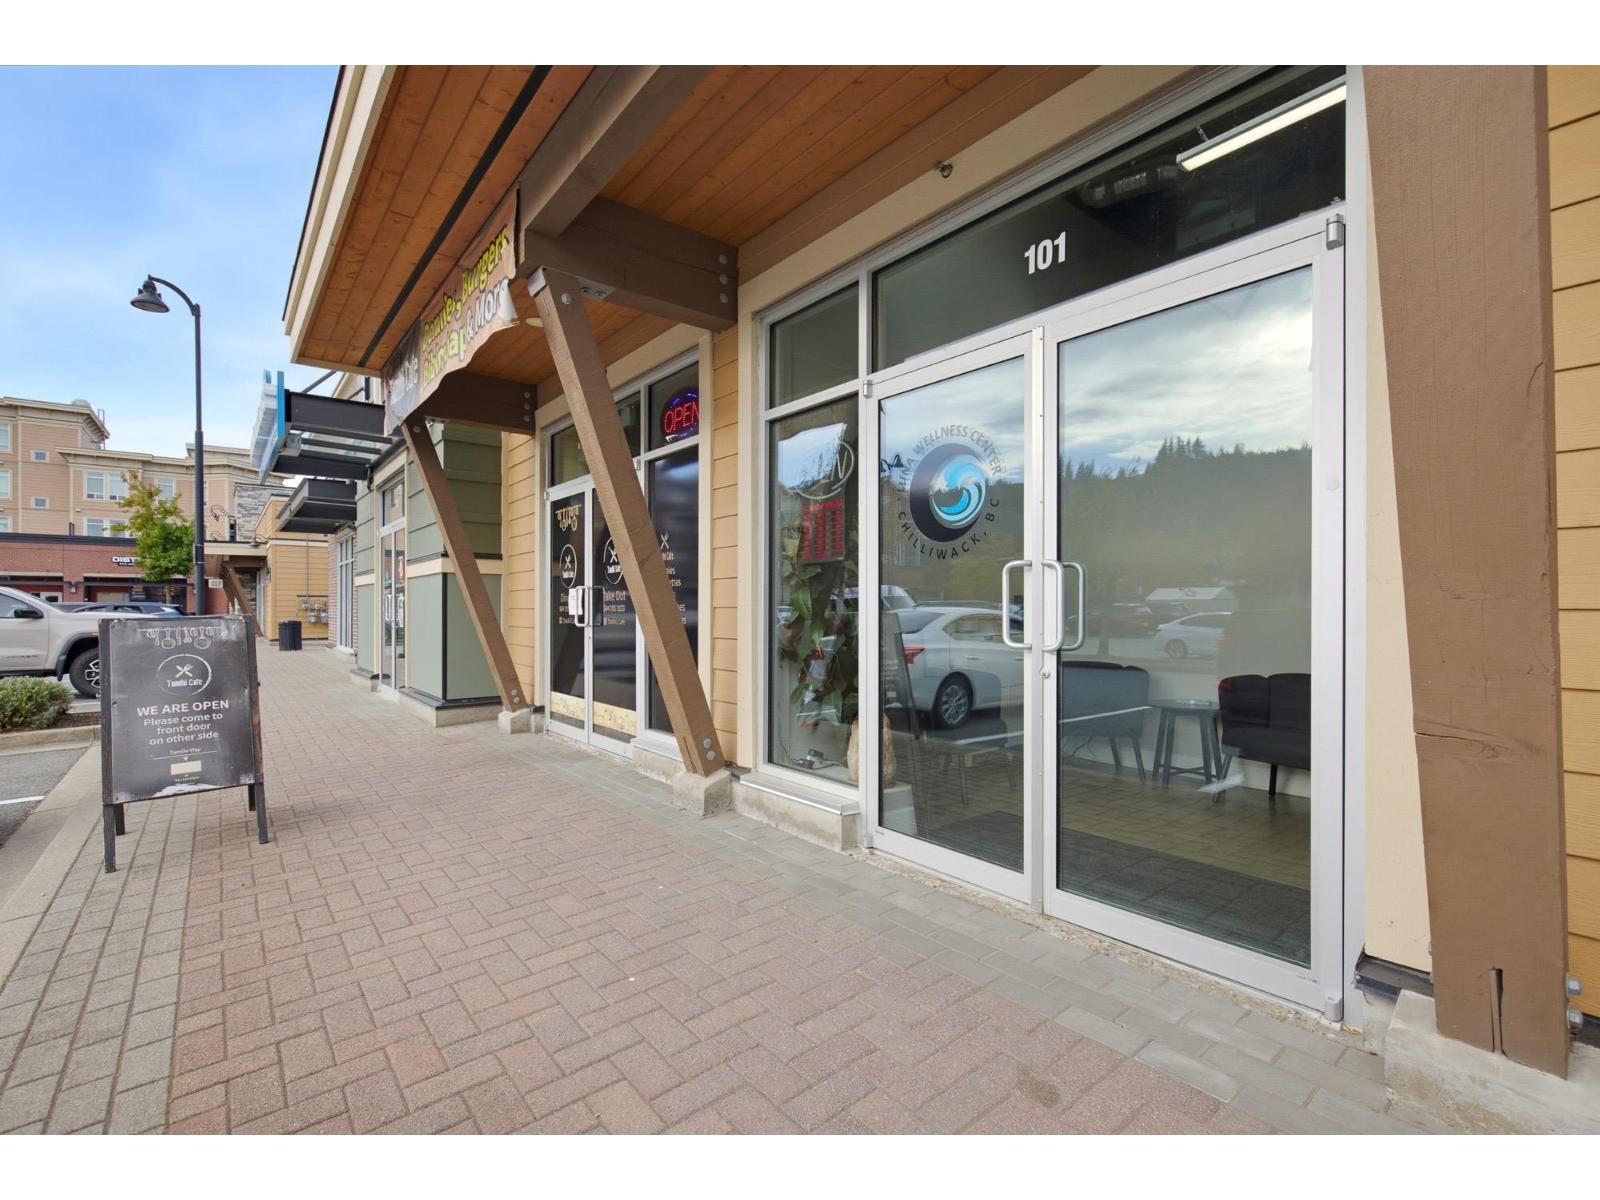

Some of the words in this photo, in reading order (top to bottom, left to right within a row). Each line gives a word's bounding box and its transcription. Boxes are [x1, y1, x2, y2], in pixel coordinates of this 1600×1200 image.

[1025, 231, 1066, 275] 101
[664, 401, 699, 432] OPEN
[913, 424, 970, 456] WELLNESS
[970, 430, 1001, 475] CENTER
[137, 706, 158, 717] WE
[162, 703, 189, 715] ARE
[192, 700, 229, 711] OPEN
[144, 716, 179, 726] Please
[181, 714, 210, 723] come
[212, 712, 223, 720] to
[157, 725, 185, 735] front
[186, 723, 211, 732] door
[149, 737, 164, 746] on
[166, 734, 196, 744] other
[197, 731, 219, 740] side
